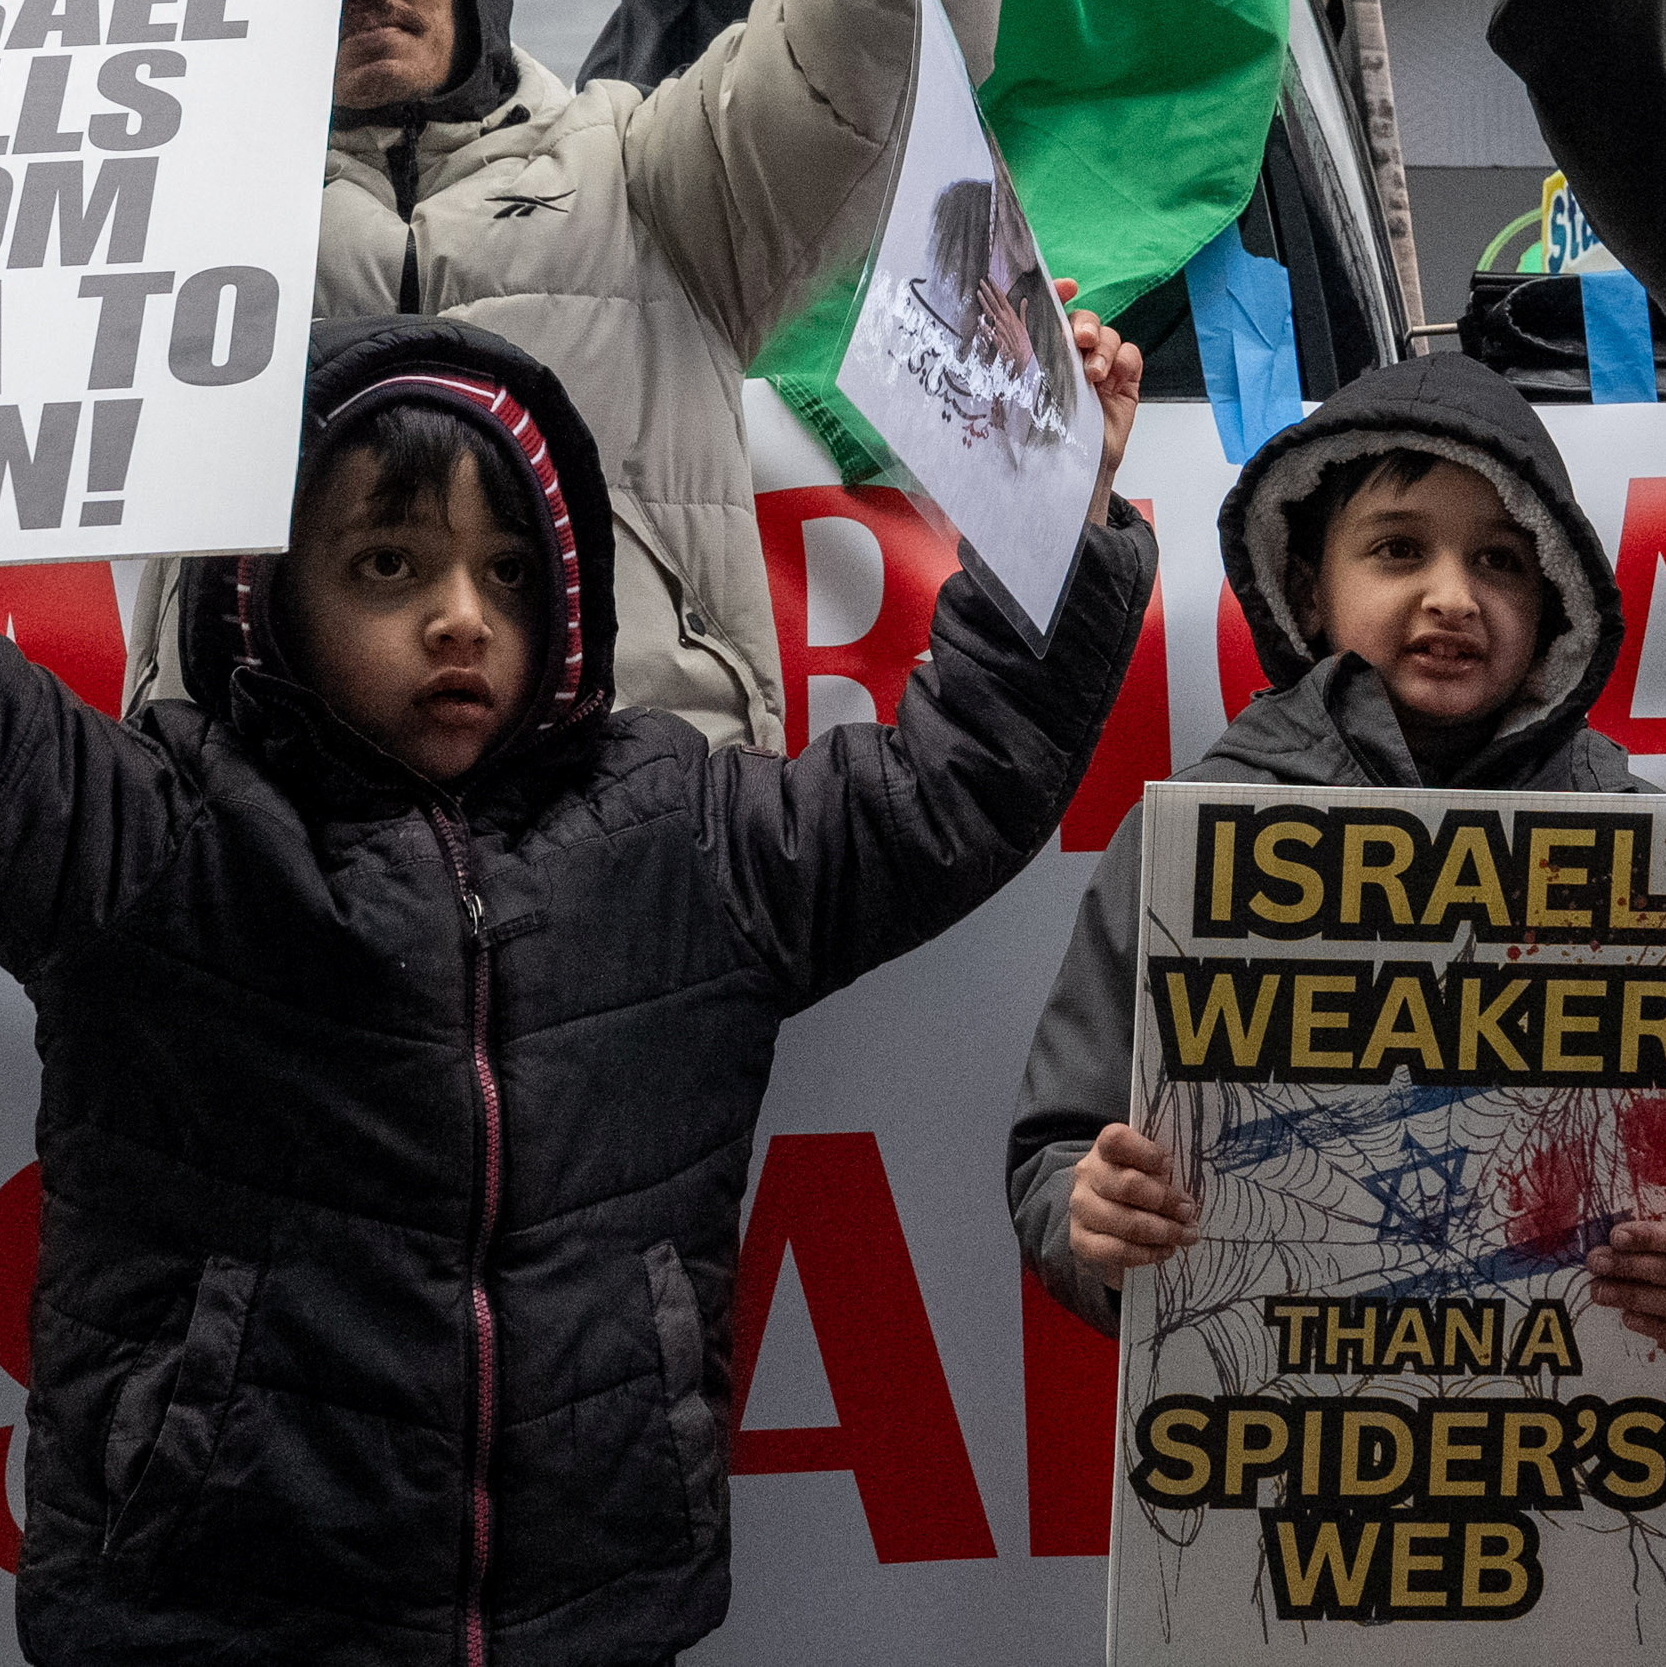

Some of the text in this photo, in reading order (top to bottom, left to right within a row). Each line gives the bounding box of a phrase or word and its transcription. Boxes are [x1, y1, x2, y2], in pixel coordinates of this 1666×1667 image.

[74, 264, 279, 389] TO
[1273, 1305, 1573, 1368] THAN A
[1276, 1521, 1530, 1608] WEB
